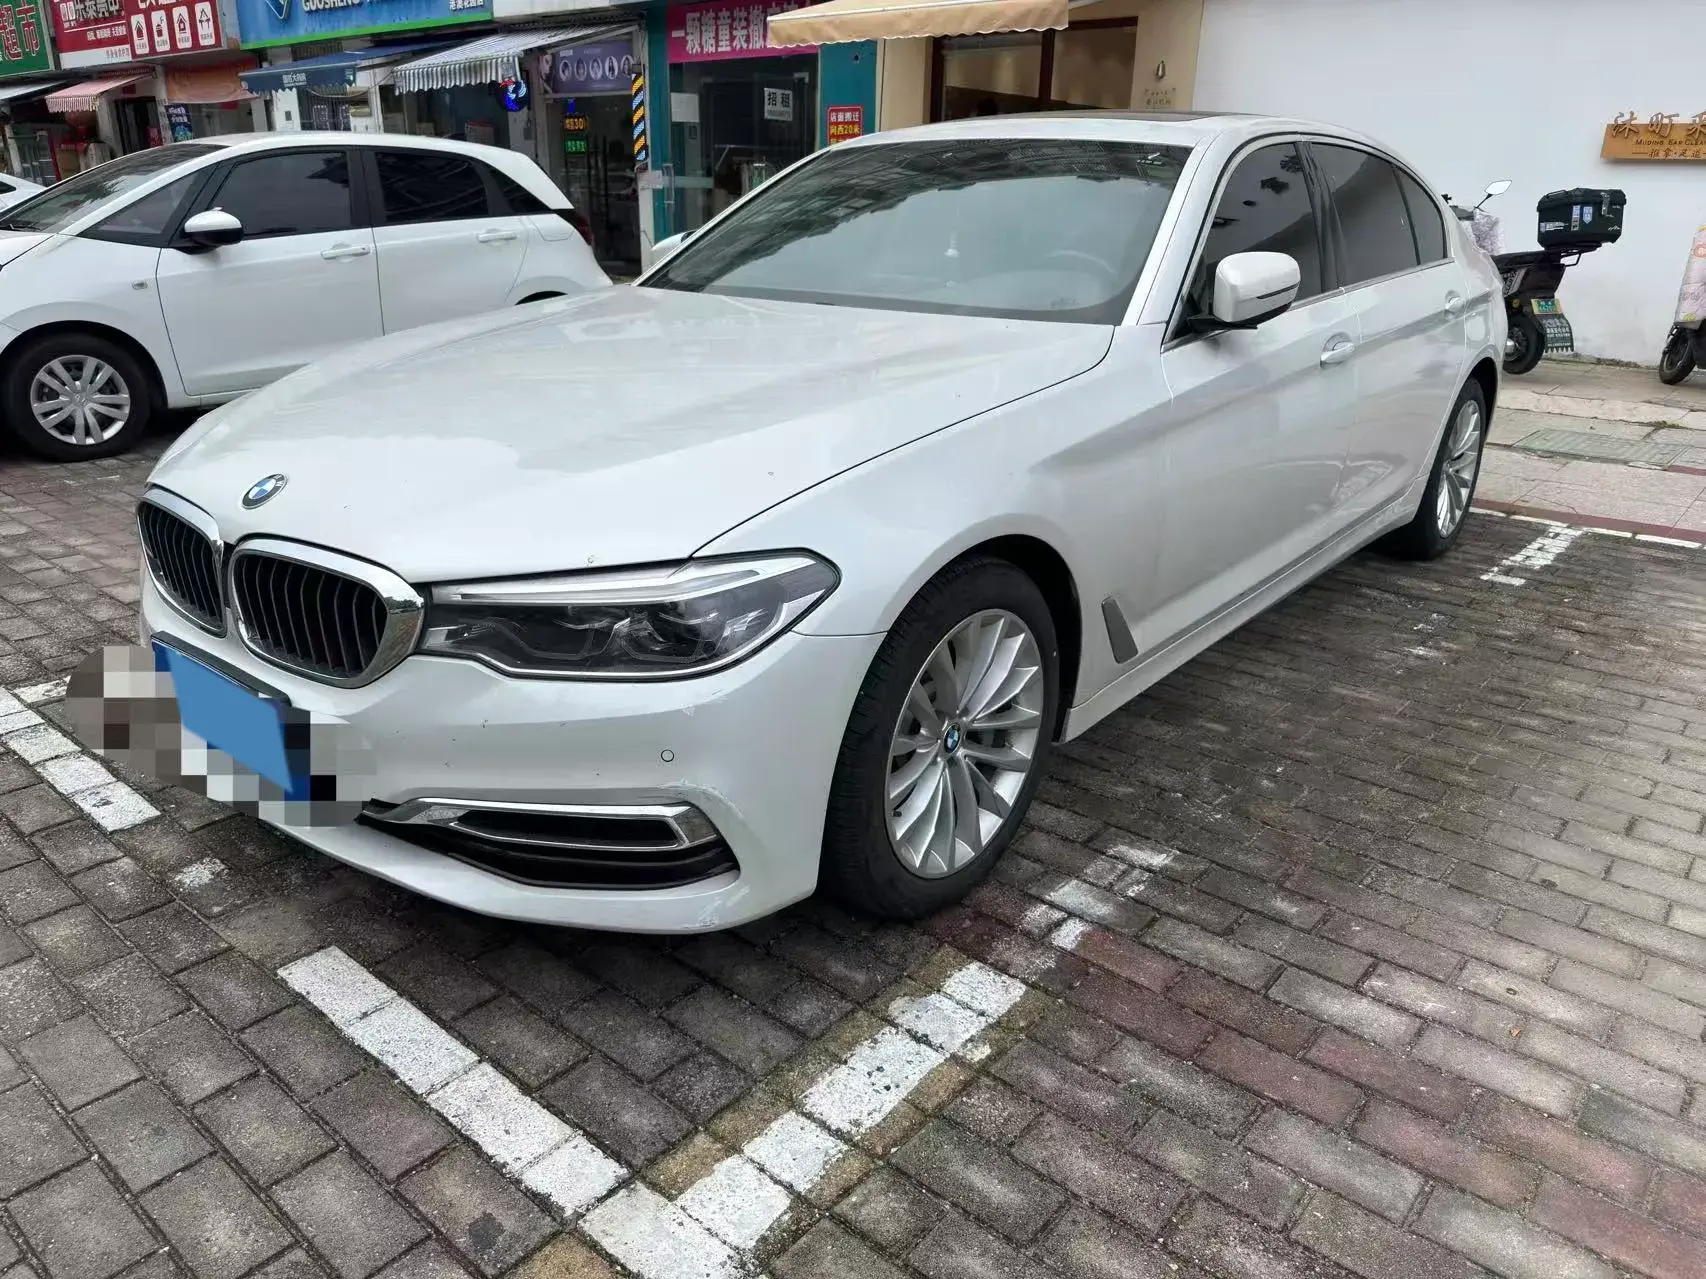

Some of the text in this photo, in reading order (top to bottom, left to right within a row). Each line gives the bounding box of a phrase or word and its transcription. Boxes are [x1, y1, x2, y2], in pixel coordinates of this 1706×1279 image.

[831, 111, 860, 122] 店面搬迁
[830, 124, 860, 135] 向西20米
